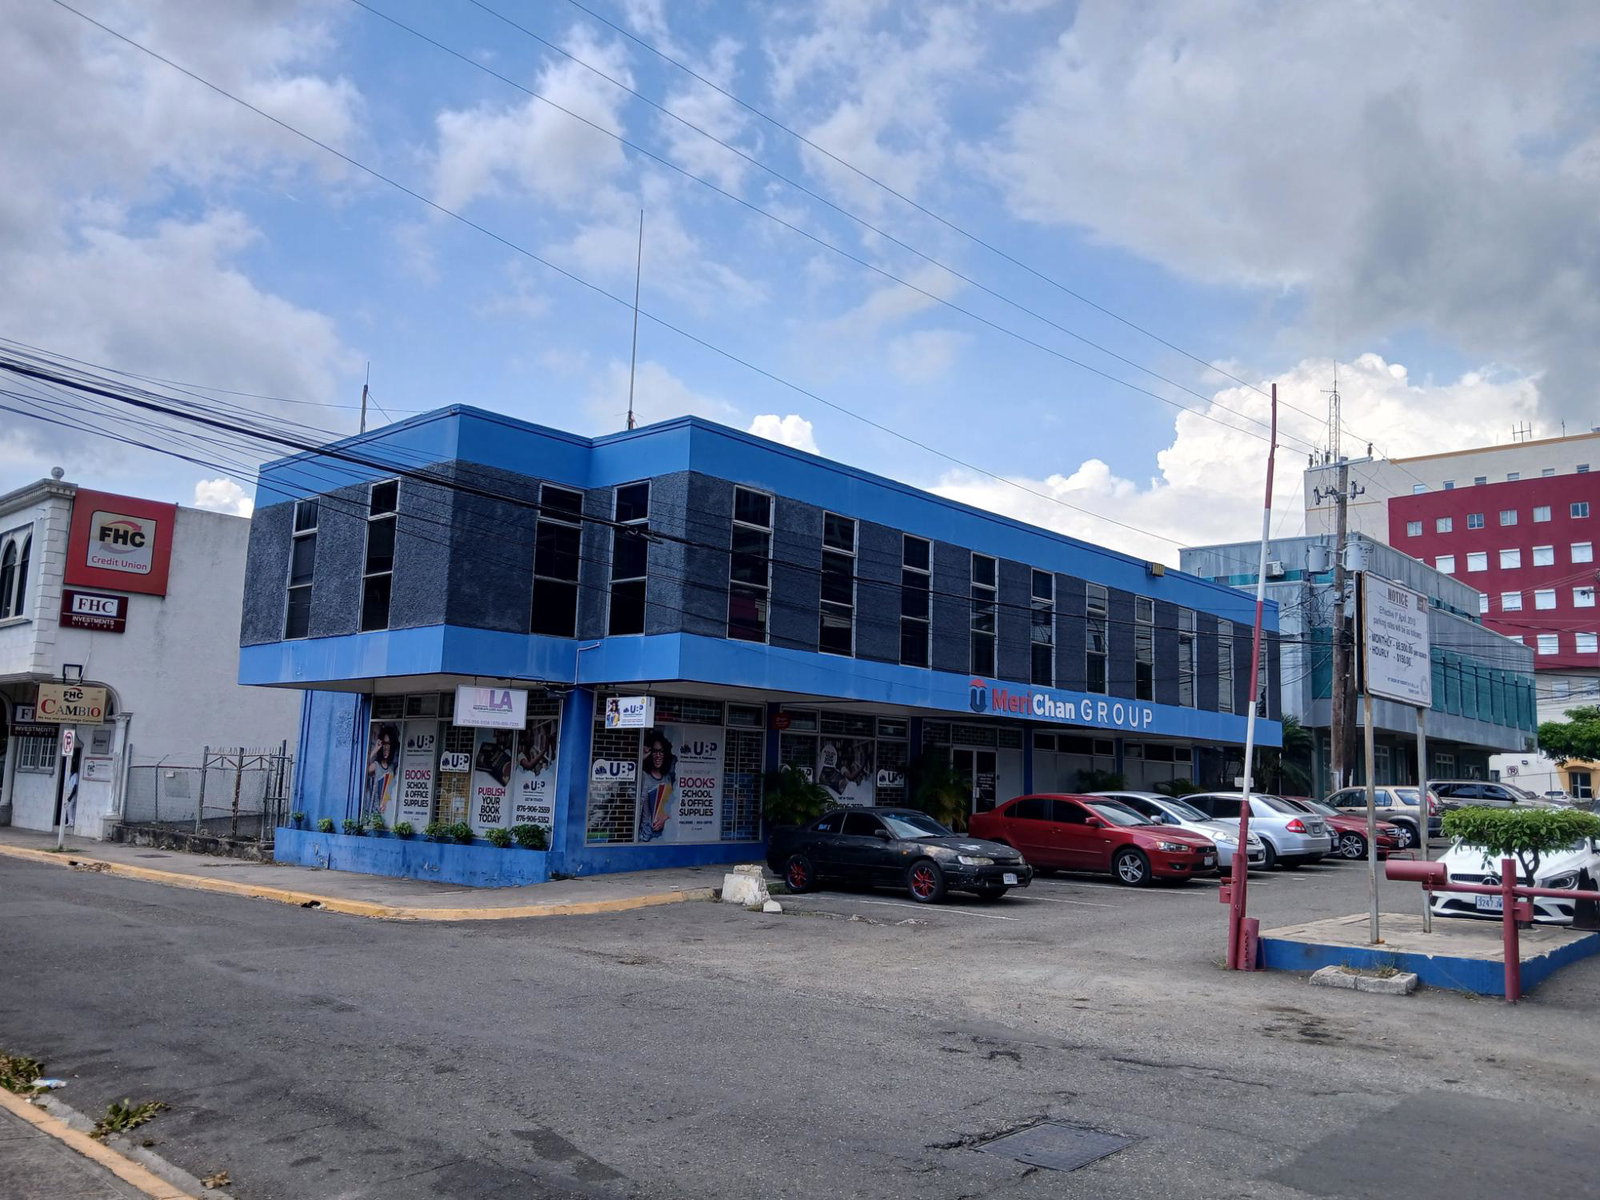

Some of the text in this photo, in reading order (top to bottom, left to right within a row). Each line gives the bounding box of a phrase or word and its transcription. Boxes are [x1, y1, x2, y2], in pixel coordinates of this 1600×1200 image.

[99, 526, 145, 547] FHC
[91, 555, 148, 570] Credit Union
[1387, 588, 1408, 607] NOTICE
[78, 597, 114, 613] FHC
[72, 616, 115, 625] INVESTMENTS
[1371, 633, 1392, 648] MONTHLY
[1371, 646, 1389, 658] HOURLY
[63, 691, 83, 699] FHC
[40, 699, 101, 717] CAMBIO
[992, 688, 1075, 720] MeriChan
[1080, 699, 1153, 729] GROUP
[405, 770, 431, 780] BOOKS
[406, 781, 429, 790] SCHOOL
[679, 777, 715, 788] BOOKS
[405, 790, 429, 799] & OFFICE
[478, 787, 505, 797] PUBLISH
[682, 790, 712, 798] SCHOOL
[403, 799, 429, 807] SUPPLIES
[482, 797, 500, 805] YOUR
[680, 799, 713, 807] & OFFICE
[480, 805, 500, 814] BOOK
[679, 808, 714, 816] SUPPLIES
[478, 814, 501, 823] TODAY
